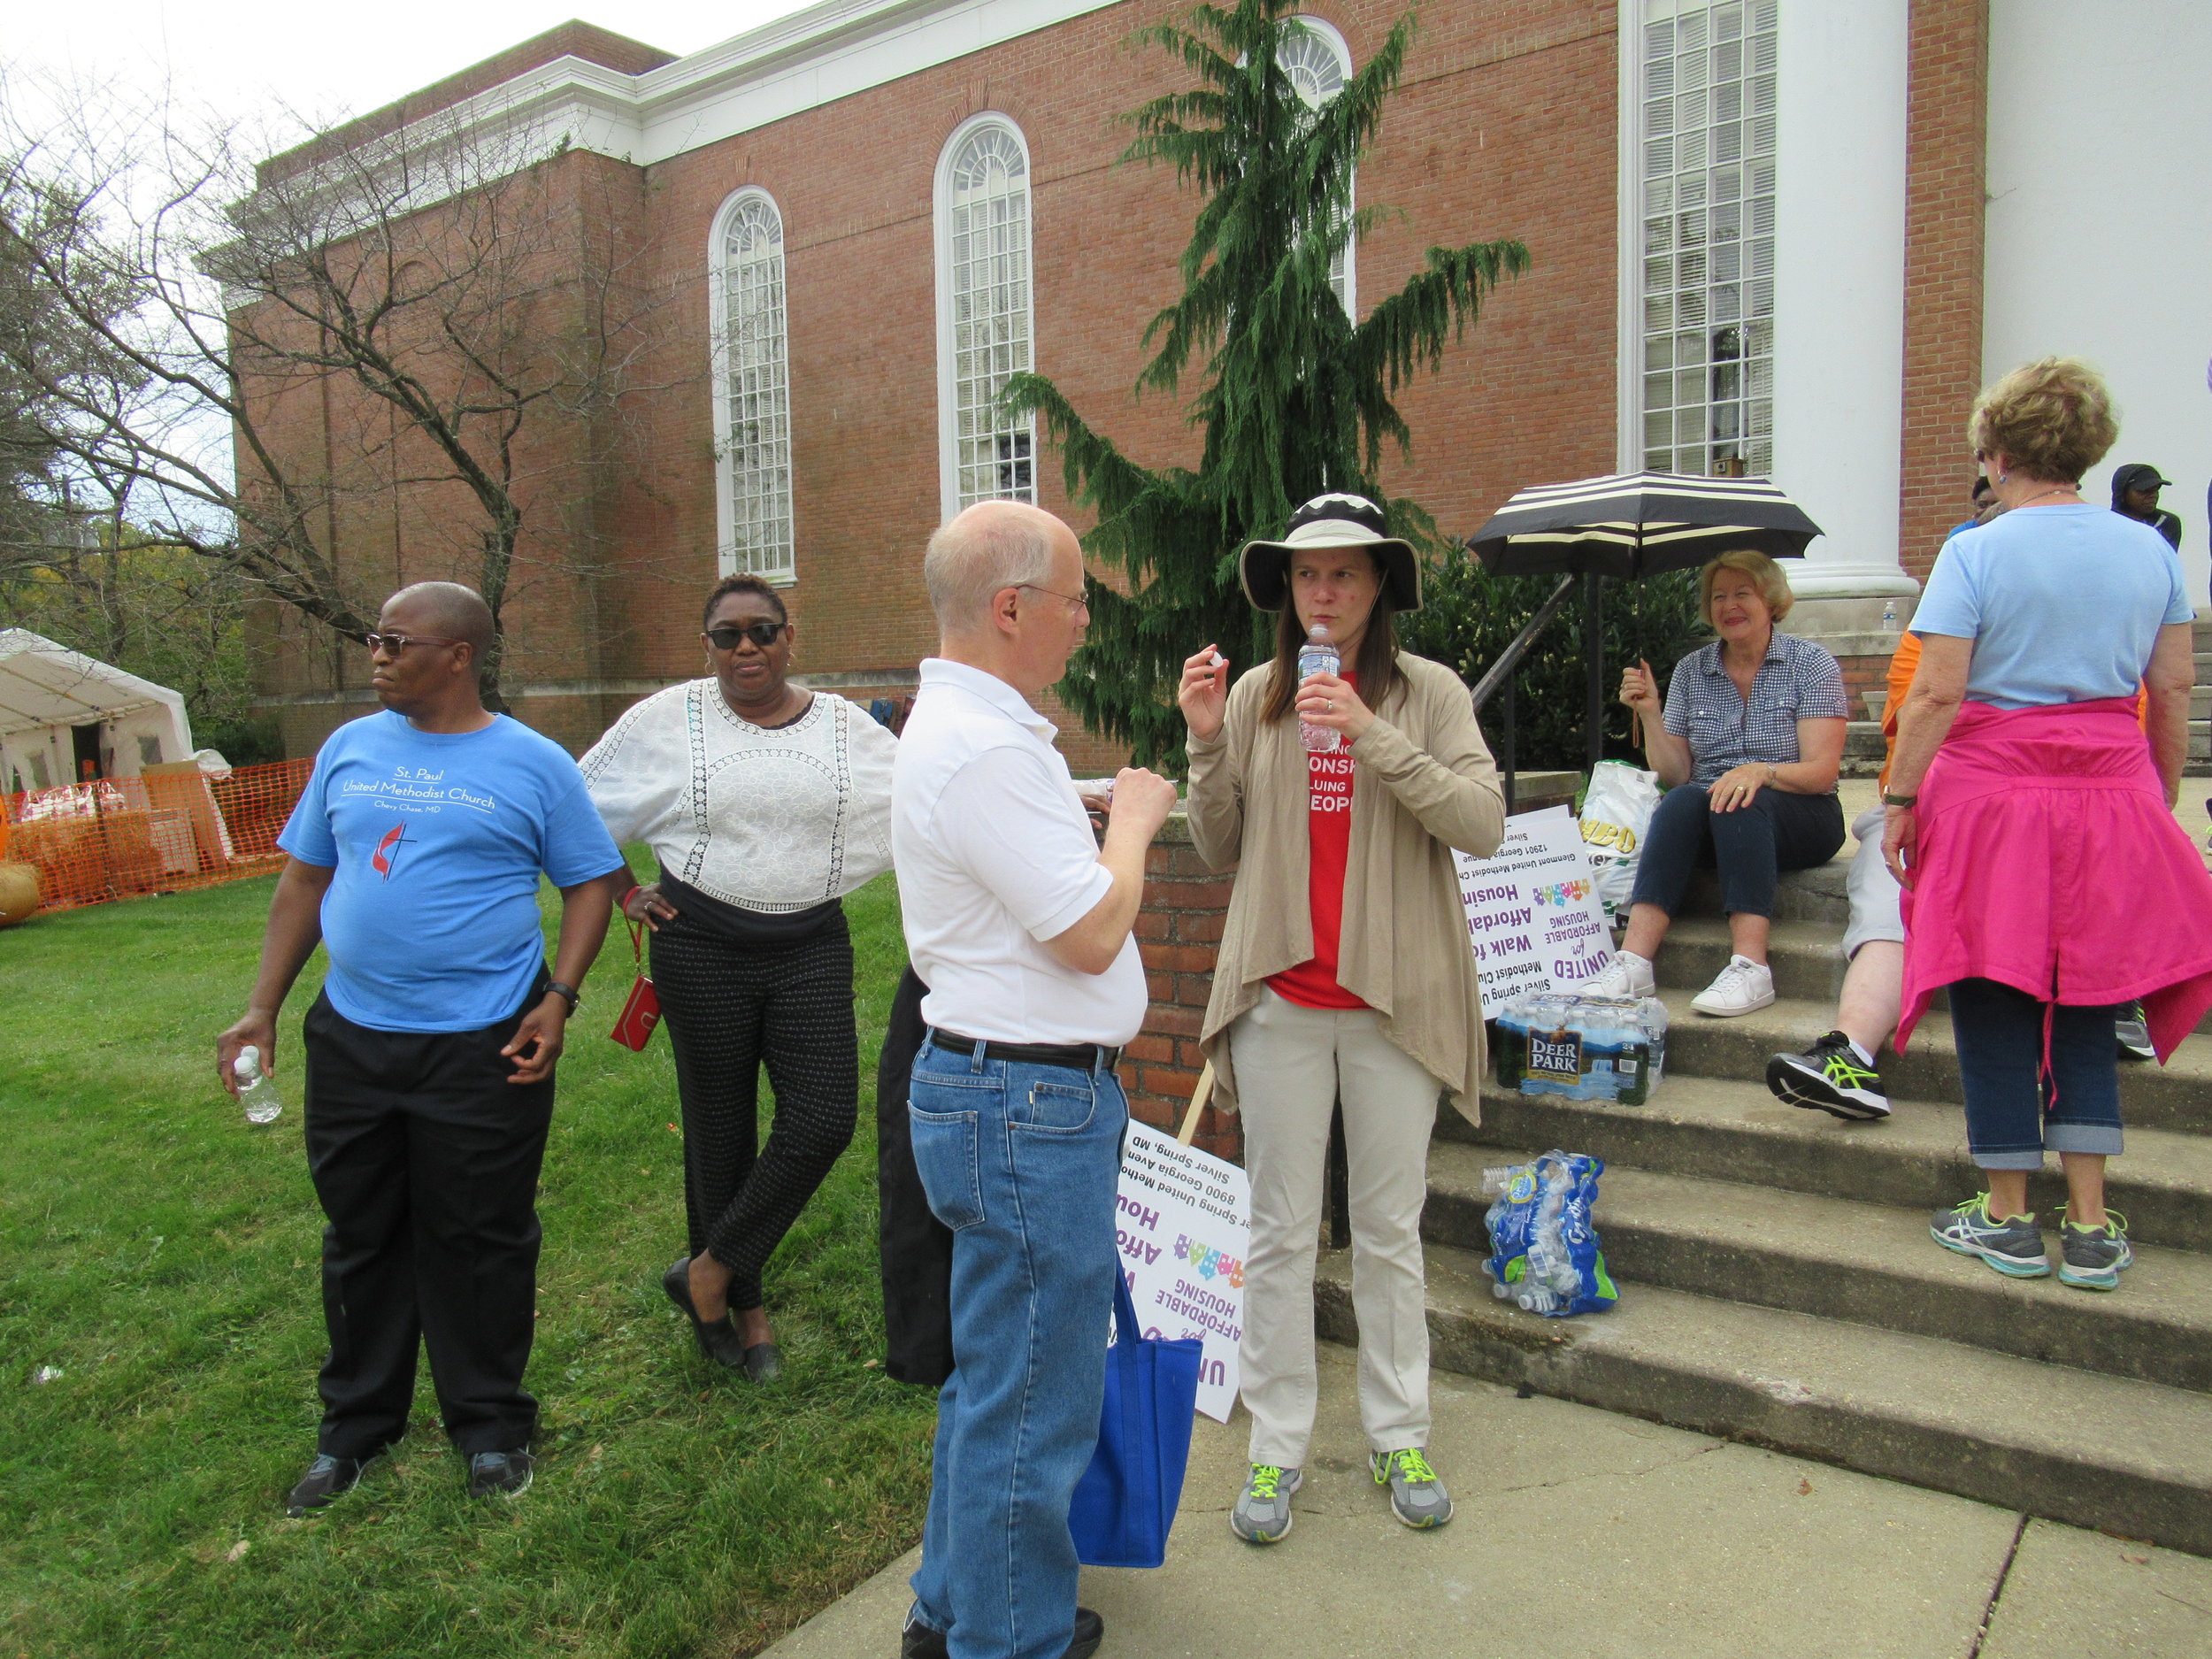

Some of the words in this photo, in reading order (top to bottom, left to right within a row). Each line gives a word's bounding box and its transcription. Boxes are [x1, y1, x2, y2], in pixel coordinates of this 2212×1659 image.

[395, 766, 411, 779] St.
[416, 768, 444, 780] Paul
[342, 780, 380, 792] United
[380, 781, 444, 798] Methodist
[449, 787, 495, 810] Church
[374, 800, 398, 810] Chevy
[1310, 795, 1353, 812] EOP
[1507, 833, 1528, 841] Silver
[1494, 848, 1523, 858] Georgia
[1525, 843, 1548, 855] 12901
[1511, 860, 1537, 871] United
[1539, 853, 1576, 866] Glenmont
[1471, 864, 1510, 878] Methodist
[1549, 910, 1590, 929] HOUSING
[1545, 922, 1601, 945] AFFORDABLE
[1489, 934, 1532, 957] Walk
[1571, 938, 1585, 957] for
[1497, 961, 1542, 978] Methodist
[1554, 949, 1609, 979] UNITED
[1480, 993, 1490, 1006] U
[1532, 1038, 1577, 1059] DEER
[1532, 1053, 1577, 1073] PARK
[1133, 1135, 1151, 1151] MD
[1127, 1150, 1156, 1170] Aven
[1155, 1143, 1194, 1169] Spring,
[1121, 1165, 1156, 1189] Metho
[1158, 1164, 1203, 1191] Georgia
[1195, 1163, 1230, 1185] Silver
[1157, 1181, 1195, 1207] United
[1205, 1185, 1236, 1205] 8900
[1199, 1198, 1238, 1225] Spring
[1175, 1279, 1236, 1318] HOUSING
[1156, 1289, 1242, 1342] AFFORDABLE
